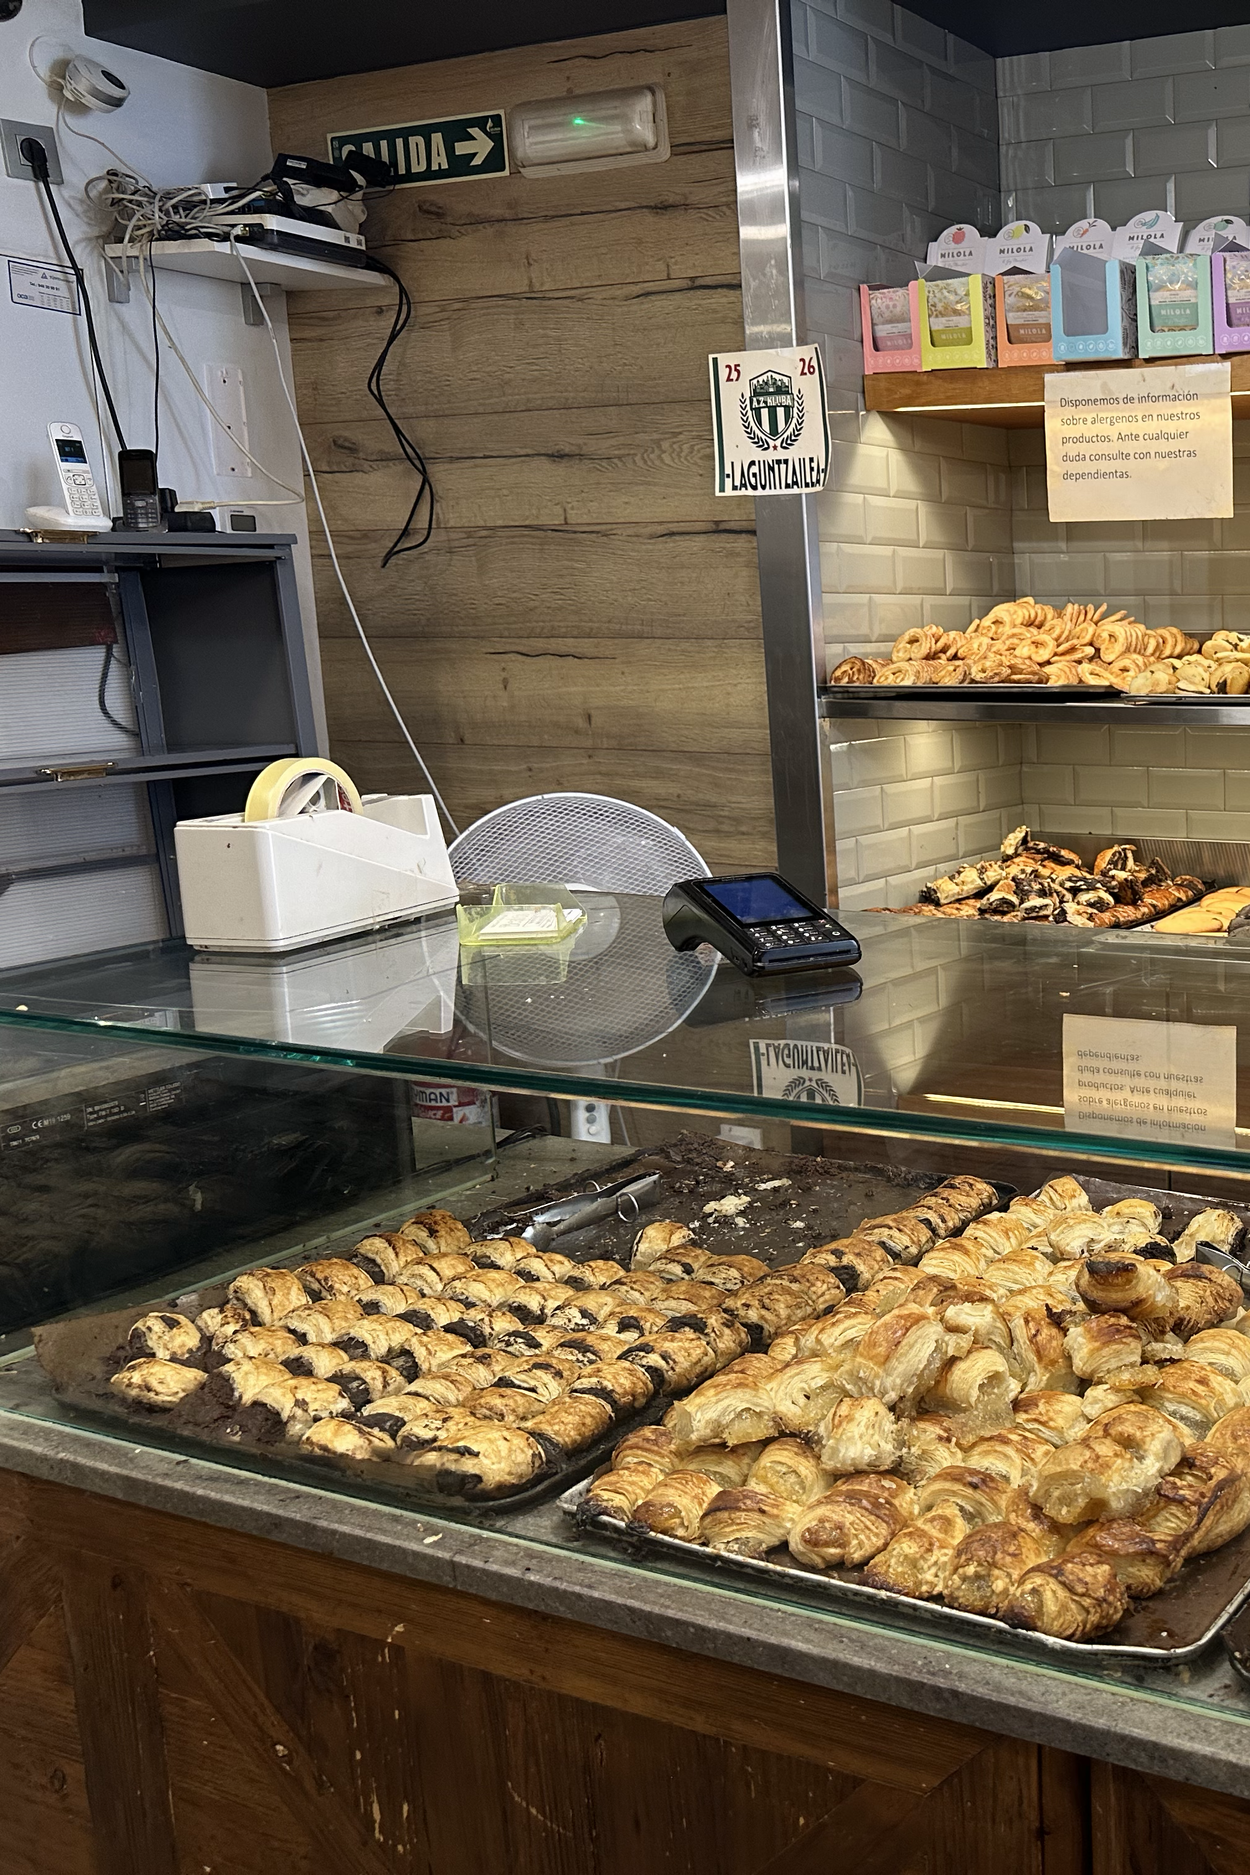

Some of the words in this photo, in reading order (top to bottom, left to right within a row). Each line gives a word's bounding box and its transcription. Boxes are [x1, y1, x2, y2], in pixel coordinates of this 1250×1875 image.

[1128, 232, 1165, 242] MILOLA
[940, 250, 973, 259] MILOLA
[999, 245, 1034, 255] MILOLA
[1160, 308, 1191, 316] MILOLA
[725, 363, 741, 382] 25
[799, 356, 815, 376] 26
[1060, 396, 1120, 409] Disponemos
[1122, 394, 1135, 404] de
[1137, 391, 1199, 404] información
[1060, 416, 1088, 427] sobre
[1090, 413, 1139, 427] alergenos
[1141, 414, 1154, 422] en
[1156, 411, 1201, 422] nuestros
[1061, 433, 1114, 446] productos.
[1116, 431, 1140, 442] Ante
[1142, 429, 1189, 442] cualquier
[1061, 452, 1087, 463] duda
[1088, 449, 1131, 462] consulte
[1133, 451, 1152, 460] con
[1154, 448, 1197, 460] nuestras
[1062, 468, 1132, 482] dependientas.
